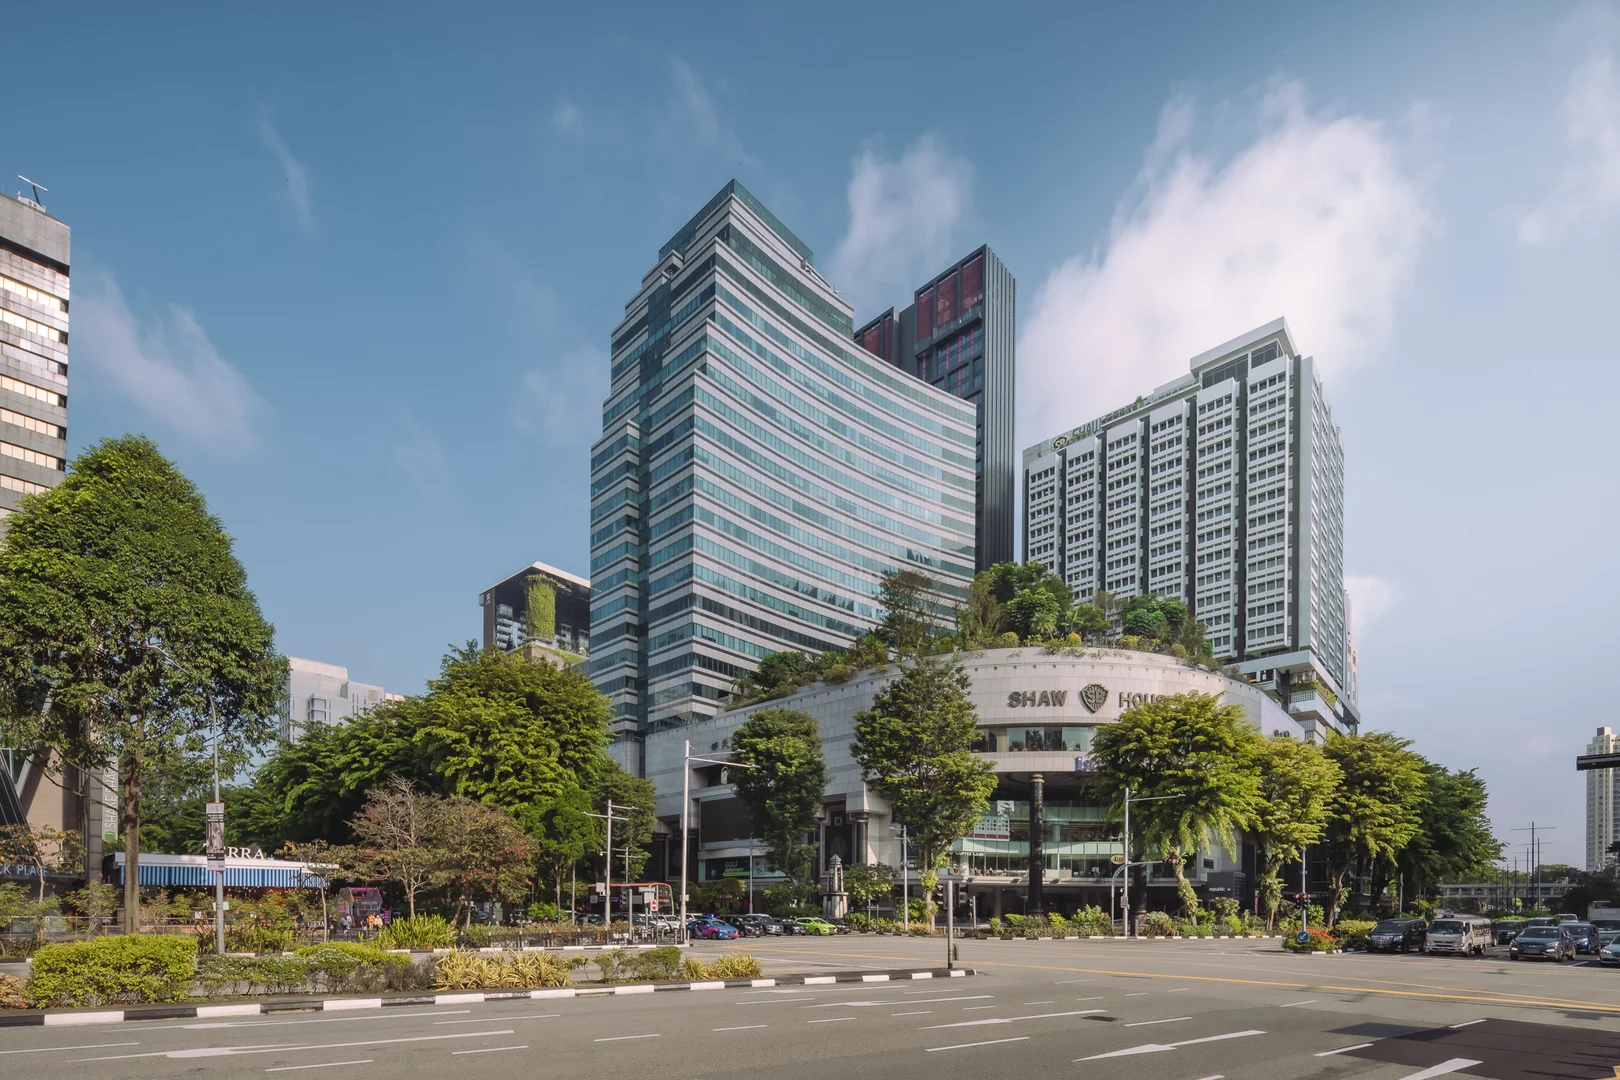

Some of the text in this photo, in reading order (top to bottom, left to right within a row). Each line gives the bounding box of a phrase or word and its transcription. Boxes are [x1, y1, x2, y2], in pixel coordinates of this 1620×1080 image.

[1007, 690, 1067, 708] SHAW
[1119, 691, 1166, 708] HOU
[104, 795, 117, 829] SHAKE
